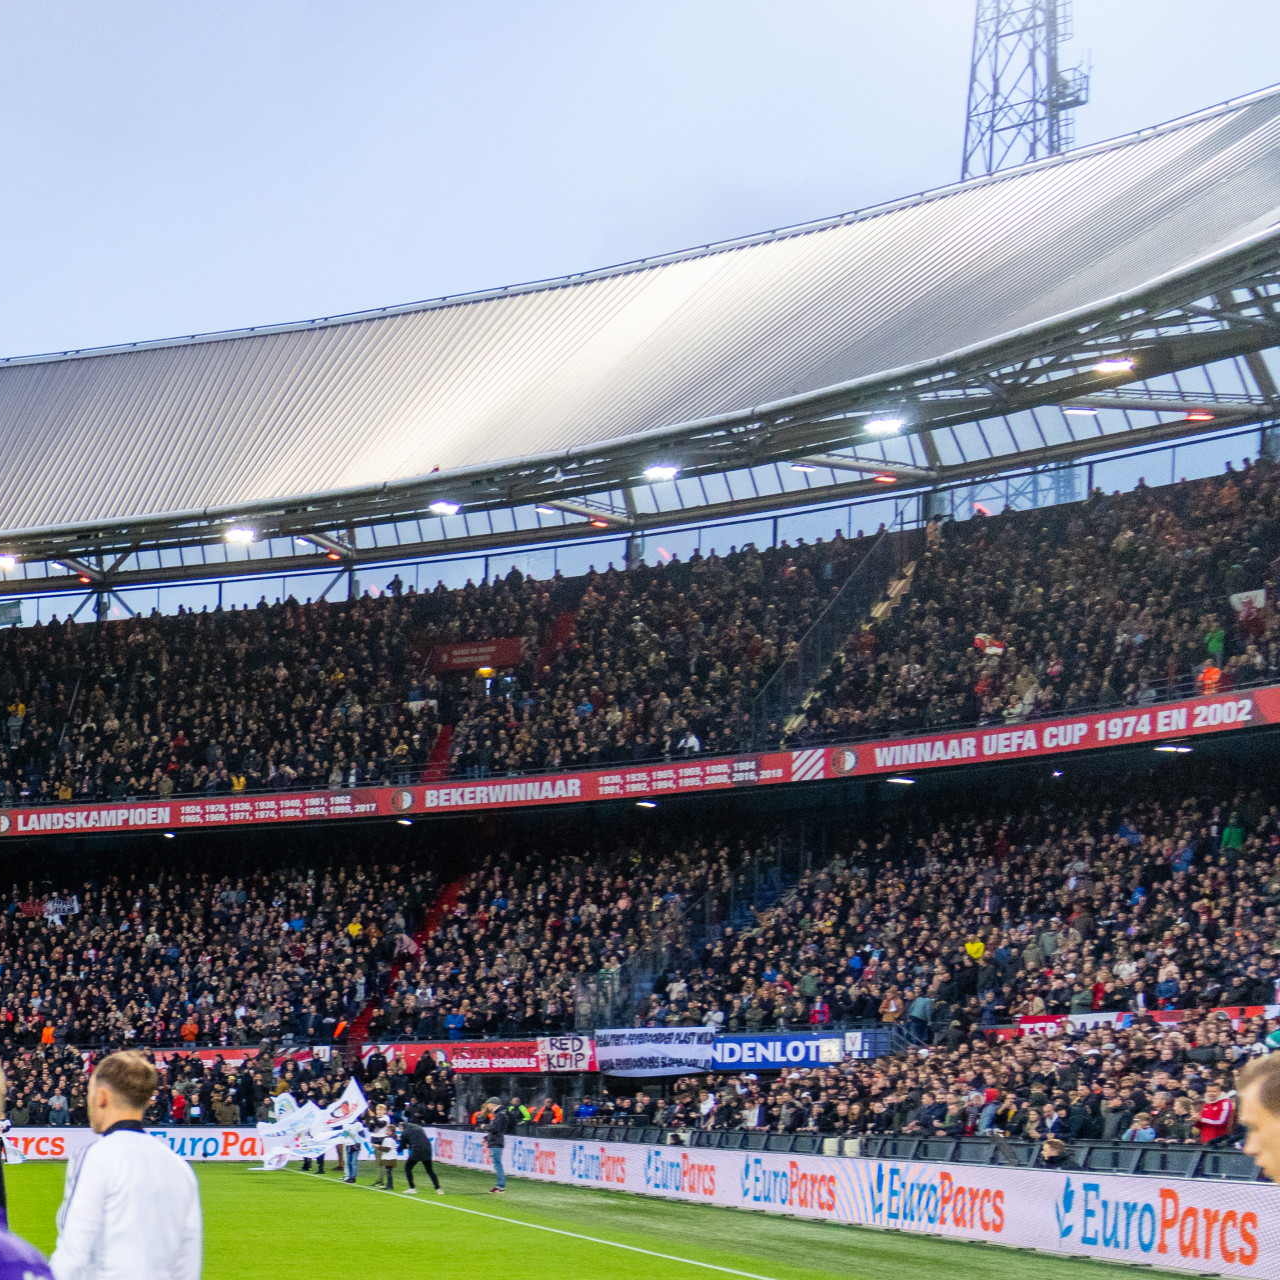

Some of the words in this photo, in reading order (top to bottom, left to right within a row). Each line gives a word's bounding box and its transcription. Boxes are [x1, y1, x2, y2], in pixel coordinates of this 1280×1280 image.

[875, 738, 976, 767] WINNAAR
[983, 729, 1037, 756] UEFA
[1043, 723, 1088, 748] CUP
[1095, 716, 1151, 742] 1974
[1157, 709, 1187, 733] EN
[1193, 699, 1253, 727] 2002
[425, 779, 581, 807] BEKERWINNAAR
[17, 807, 171, 831] LANDSKAMPIOEN
[549, 1037, 583, 1052] RED
[849, 1036, 858, 1047] V
[452, 1058, 490, 1069] SOCCER
[492, 1057, 537, 1068] SCHOOLS
[578, 1145, 626, 1184] EuroParcs
[653, 1150, 716, 1196] EuroParcs
[753, 1158, 837, 1212] EuroParcs
[887, 1168, 1005, 1233] EuroParcs
[1081, 1182, 1259, 1266] EuroParcs
